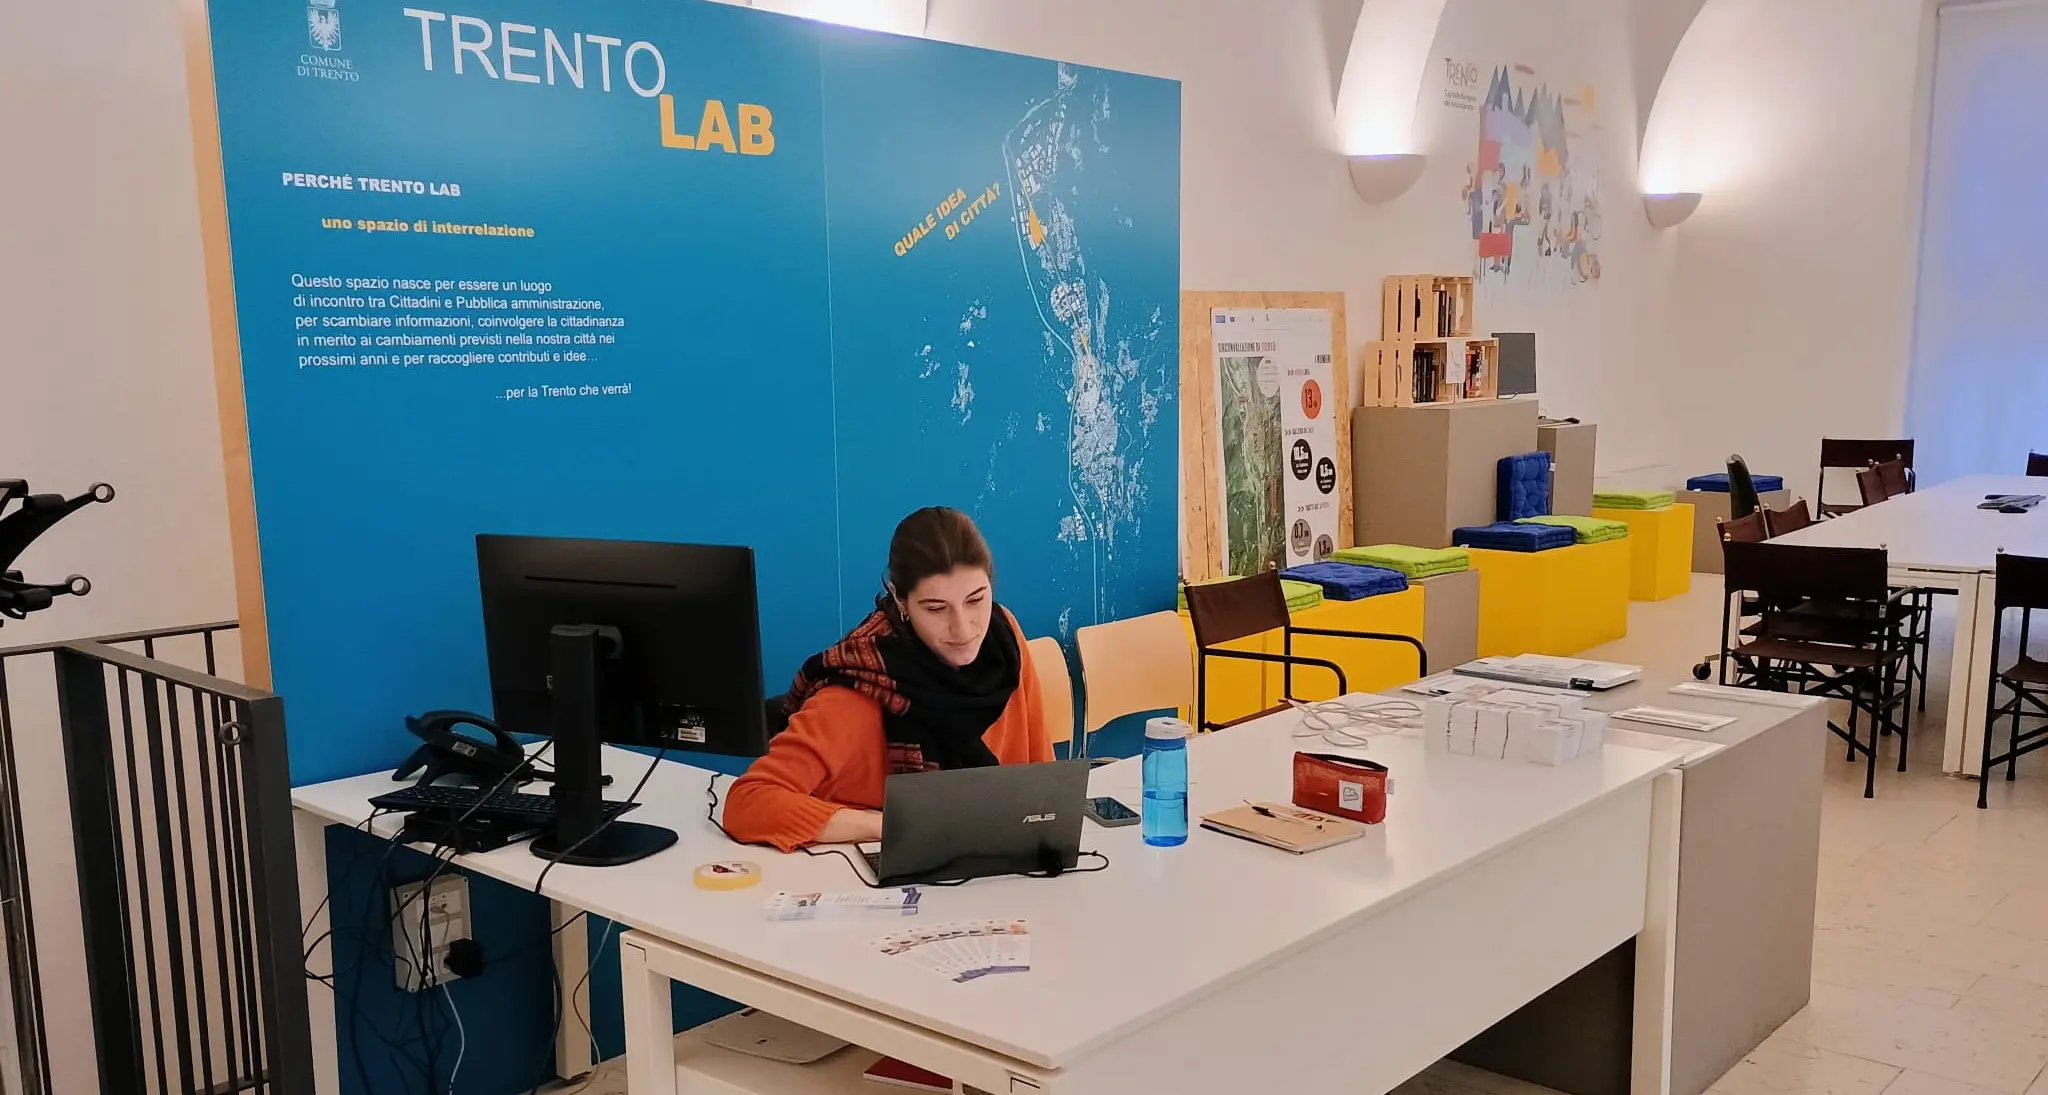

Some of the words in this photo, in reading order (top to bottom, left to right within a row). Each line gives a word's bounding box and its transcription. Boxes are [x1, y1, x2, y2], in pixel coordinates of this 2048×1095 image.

[300, 54, 353, 70] COMUNE
[403, 8, 666, 98] TRENTO
[297, 66, 310, 77] DI
[312, 67, 360, 82] TRENTO
[659, 93, 775, 156] LAB
[357, 177, 425, 195] TRENTO
[429, 183, 462, 197] LAB
[944, 220, 960, 240] DI
[960, 182, 1000, 226] CITTÀ?
[321, 217, 352, 229] uno
[357, 218, 409, 233] spazio
[413, 219, 428, 233] di
[432, 220, 535, 238] interrelazione
[894, 213, 937, 256] QUALE
[936, 188, 967, 220] IDEA
[291, 273, 342, 288] Questo
[345, 275, 389, 291] spazio
[393, 279, 431, 290] nasce
[435, 279, 455, 292] per
[458, 280, 499, 291] essere
[502, 280, 517, 291] un
[520, 279, 552, 294] luogo
[293, 294, 306, 308] di
[310, 294, 365, 308] incontro
[368, 296, 386, 308] tra
[389, 295, 441, 309] Cittadini
[444, 299, 453, 309] e
[456, 296, 508, 310] Pubblica
[511, 297, 605, 312] amministrazione,
[295, 316, 318, 330] per
[322, 314, 391, 328] scambiare
[395, 314, 474, 329] informazioni,
[478, 315, 545, 330] coinvolgere
[547, 315, 557, 327] la
[560, 315, 625, 327] cittadinanza
[296, 333, 309, 347] in
[314, 333, 357, 347] merito
[360, 333, 372, 347] ai
[375, 333, 456, 347] cambiamenti
[459, 333, 502, 348] previsti
[505, 333, 533, 345] nella
[536, 333, 571, 345] nostra
[573, 333, 596, 345] città
[599, 333, 615, 344] nei
[299, 352, 356, 369] prossimi
[360, 352, 388, 366] anni
[391, 355, 400, 365] e
[403, 354, 424, 367] per
[428, 351, 495, 367] raccogliere
[498, 350, 550, 363] contributi
[553, 352, 561, 362] e
[528, 386, 539, 398] la
[541, 384, 577, 397] Trento
[579, 384, 599, 396] che
[601, 382, 632, 395] verrà!
[1304, 388, 1313, 409] 13
[1022, 813, 1056, 823] ASUS
